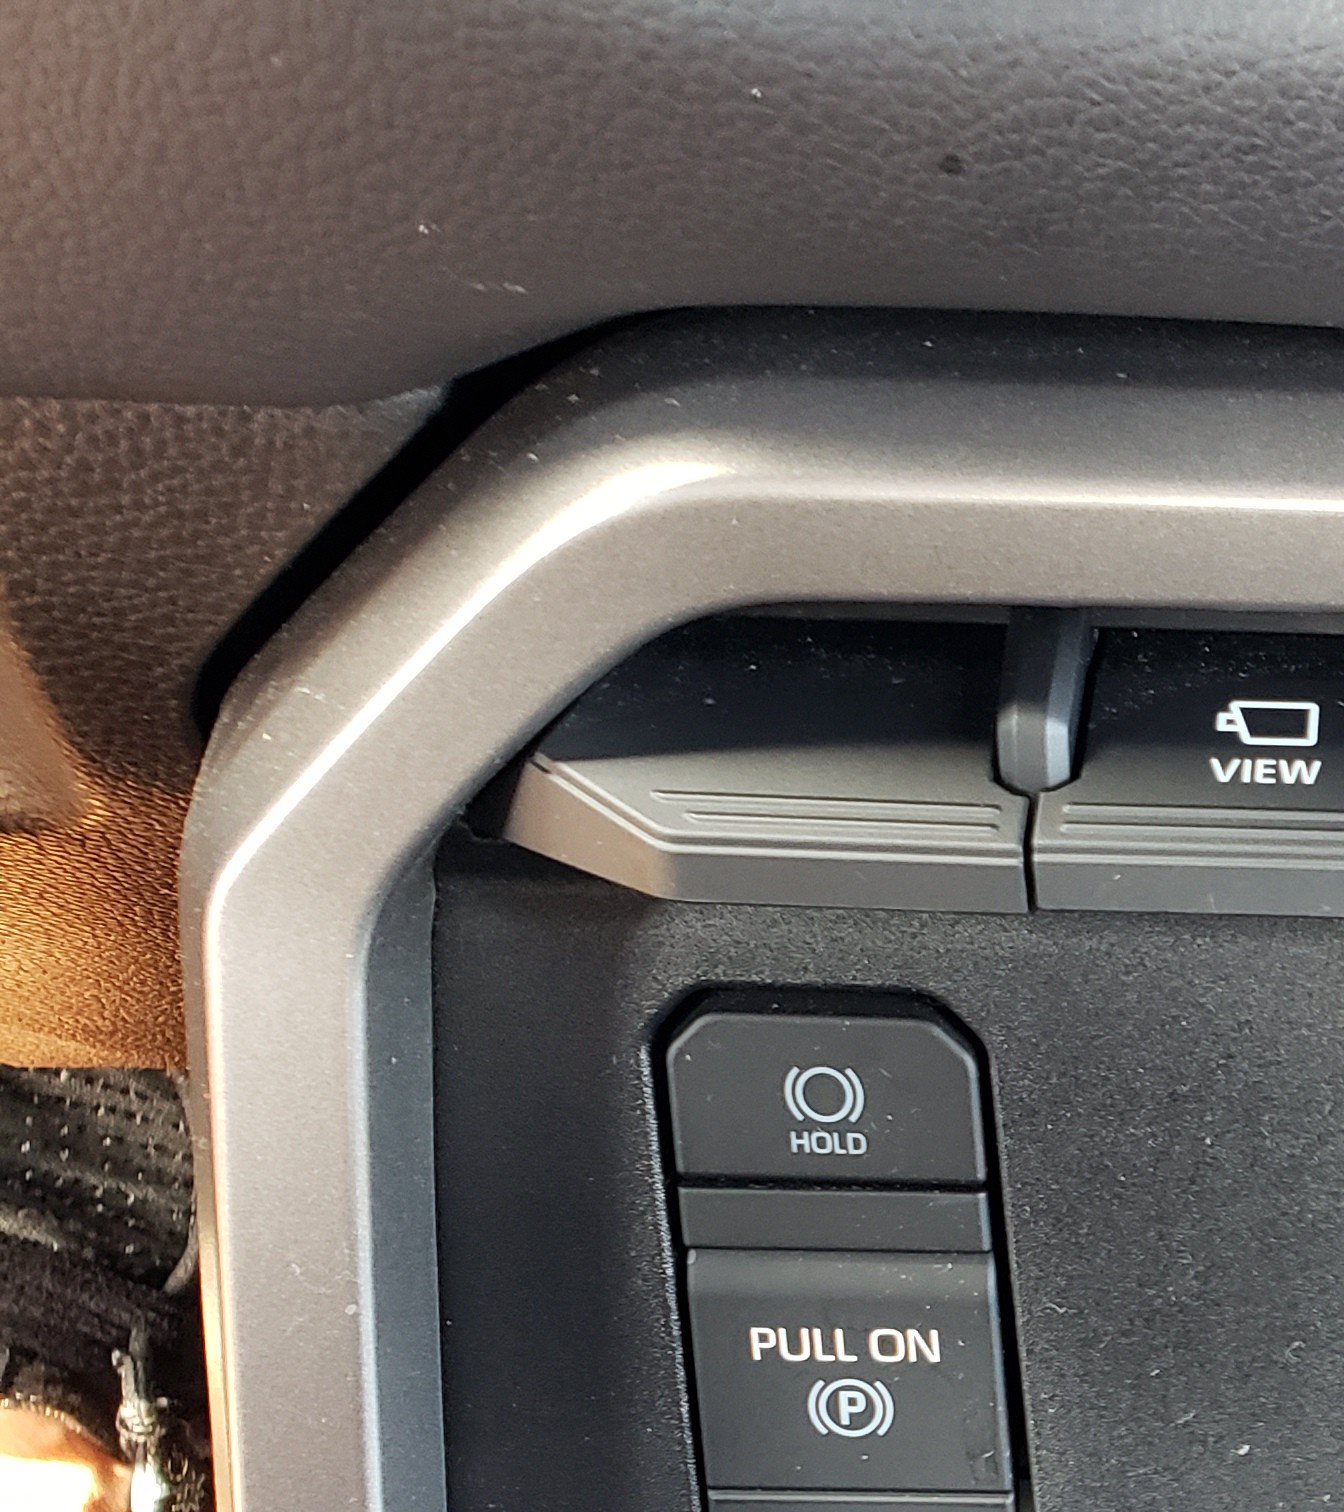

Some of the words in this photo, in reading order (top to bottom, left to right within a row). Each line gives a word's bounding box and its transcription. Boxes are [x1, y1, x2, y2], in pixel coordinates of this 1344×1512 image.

[1208, 756, 1322, 785] VIEW
[789, 1130, 868, 1156] HOLD
[749, 1326, 859, 1363] PULL
[868, 1327, 942, 1364] ON
[838, 1390, 867, 1426] P
